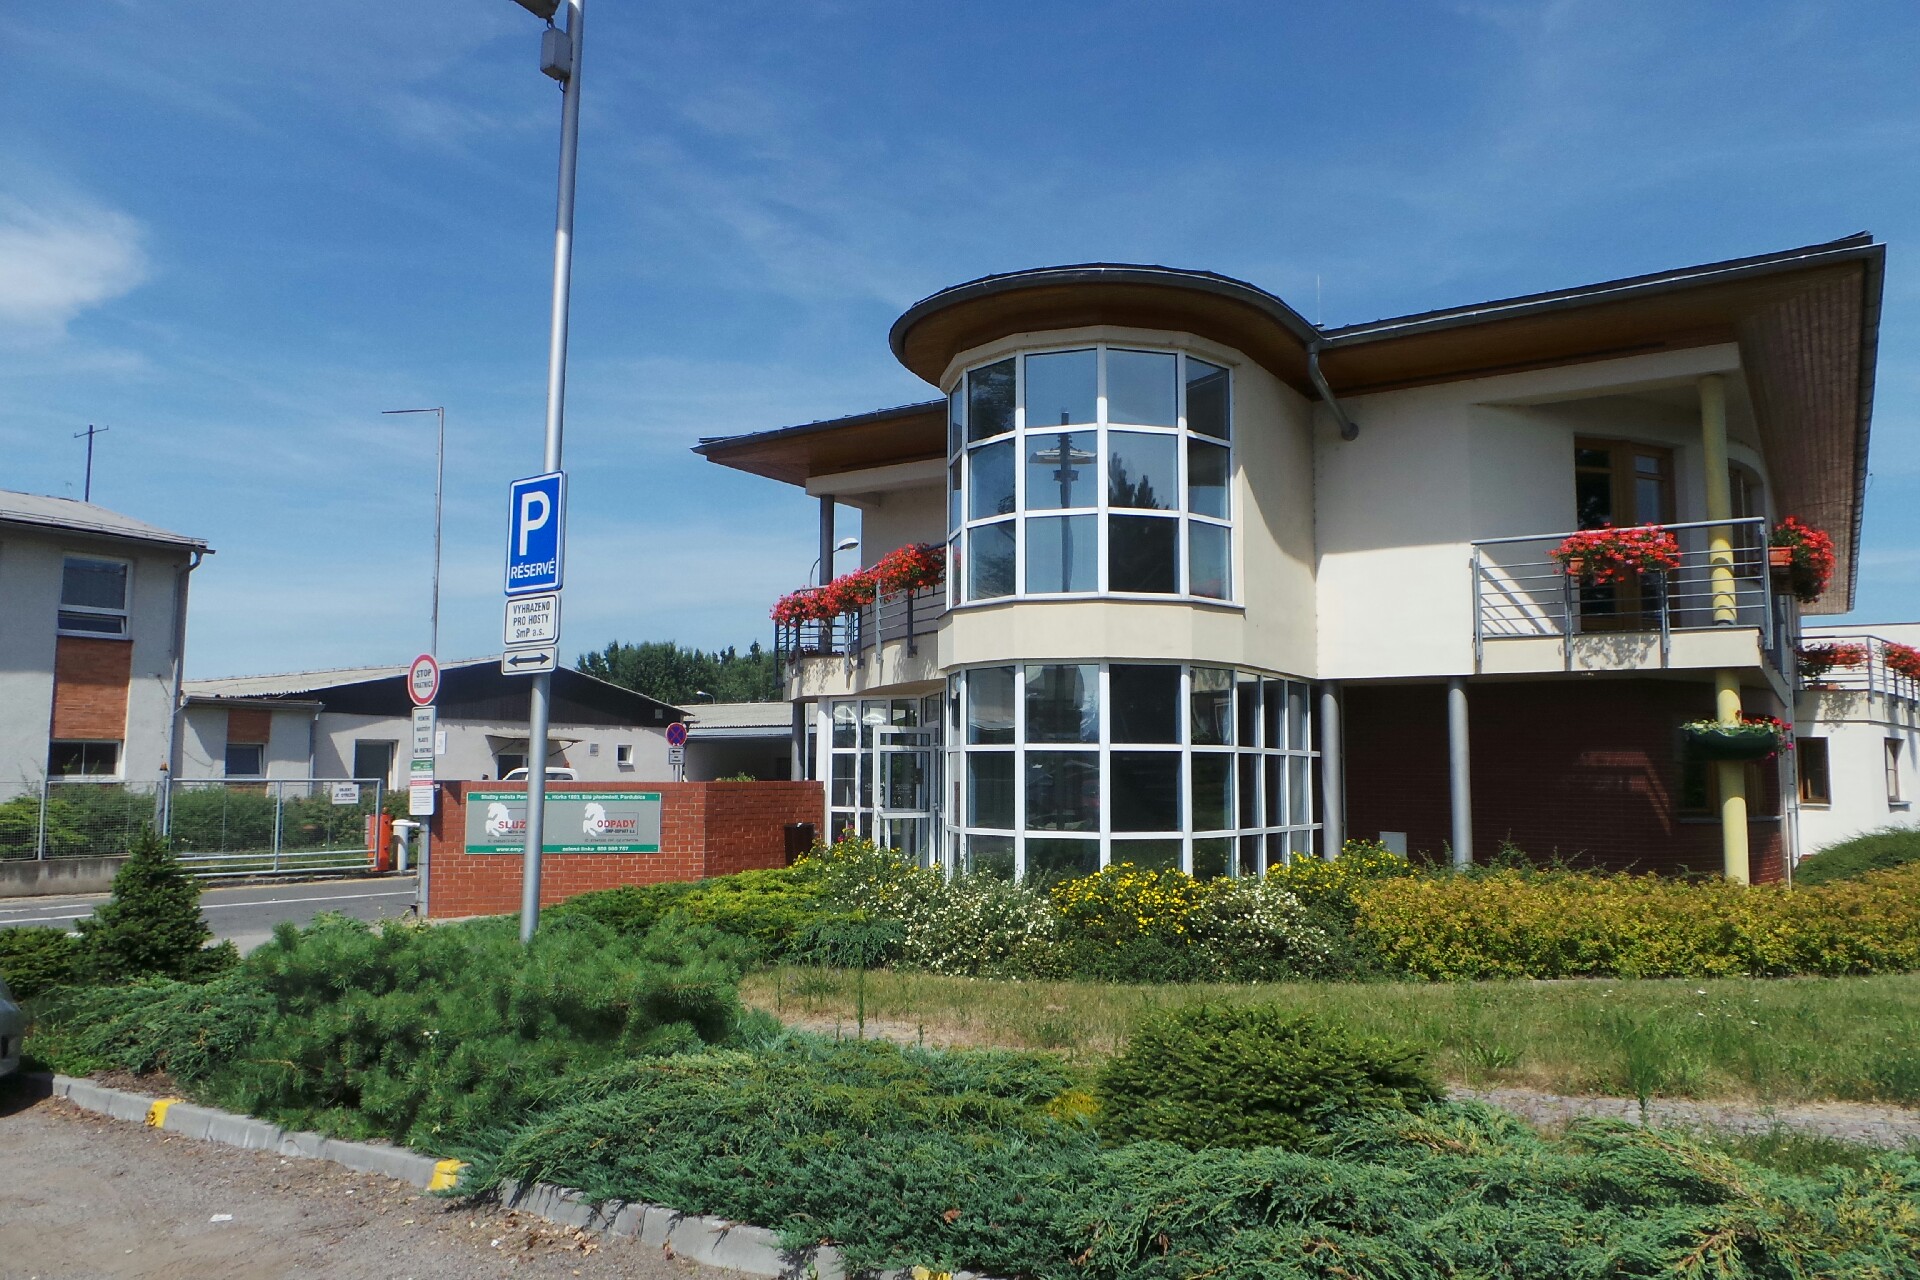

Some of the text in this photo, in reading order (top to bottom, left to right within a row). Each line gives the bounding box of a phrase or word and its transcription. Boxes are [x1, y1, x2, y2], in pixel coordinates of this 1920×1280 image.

[519, 491, 550, 556] P
[510, 557, 555, 579] RÉSERVÉ
[513, 601, 551, 614] VYHRAZENO
[513, 613, 549, 626] PRO HOSTY
[516, 628, 545, 638] SmP a.s.
[416, 668, 432, 678] STOP
[498, 819, 526, 829] SLUŽ
[596, 819, 636, 828] ODPADY
